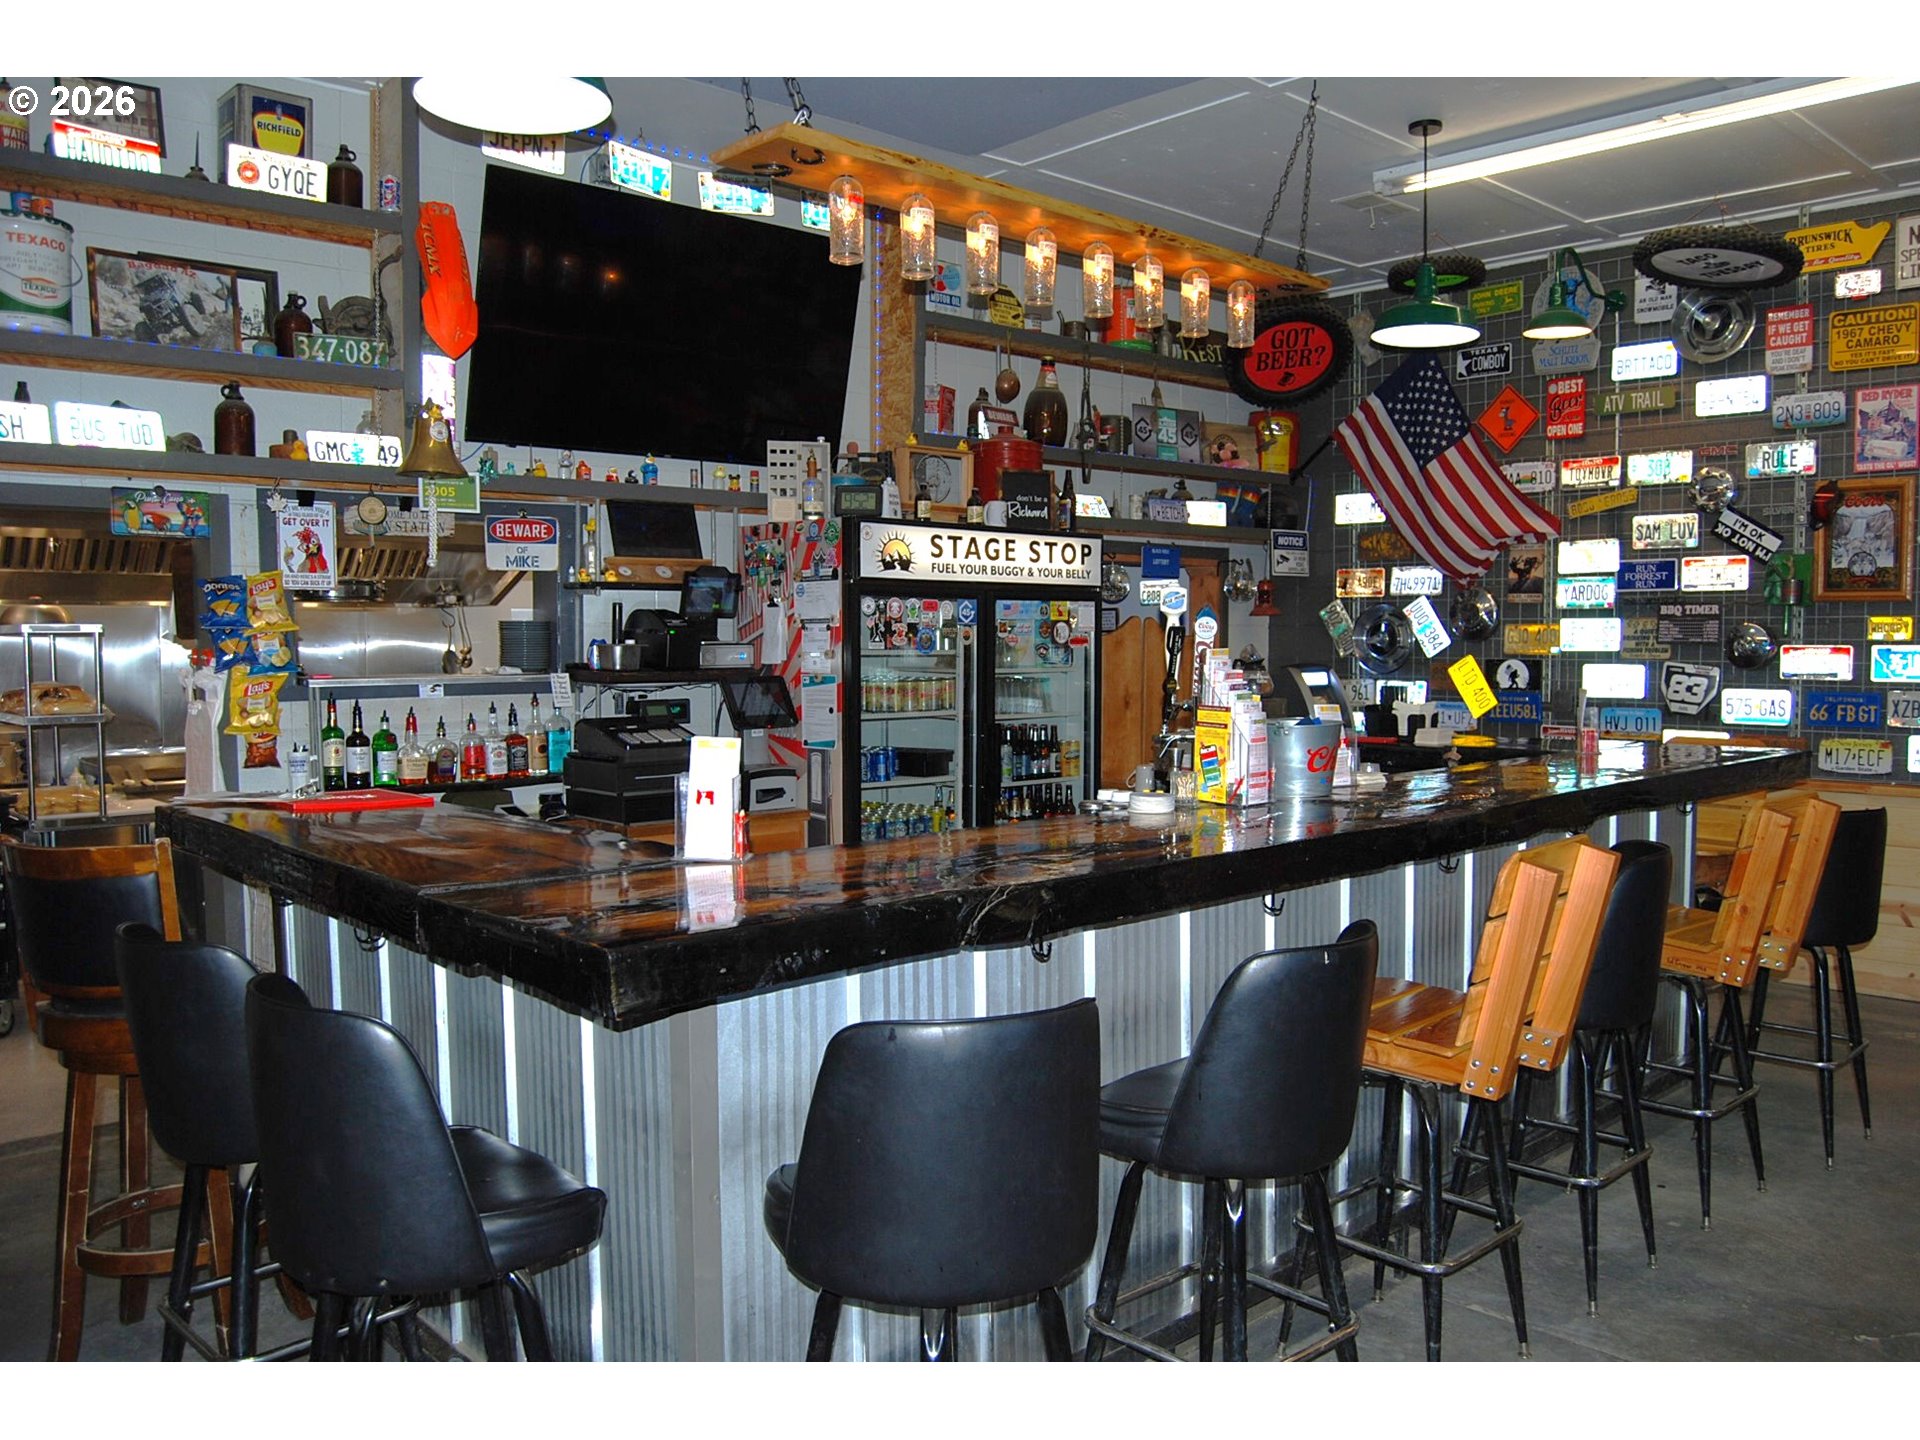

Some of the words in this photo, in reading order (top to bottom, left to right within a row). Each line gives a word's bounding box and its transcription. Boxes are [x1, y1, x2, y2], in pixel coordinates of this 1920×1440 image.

[256, 120, 301, 138] RICHFIELD
[268, 164, 318, 198] GYQE
[6, 231, 66, 253] TEXACO
[1806, 242, 1836, 253] TIRES
[1676, 252, 1719, 266] TACO
[23, 282, 57, 294] TEXACO
[1472, 290, 1491, 301] JOHN
[1494, 285, 1519, 297] DEERE
[930, 292, 951, 304] MOTOR
[951, 296, 961, 307] OIL
[1636, 303, 1675, 314] SNOWMOBILE
[1767, 308, 1810, 321] REMEMBER
[1833, 307, 1916, 327] CAUTION!
[1768, 325, 1778, 335] IF
[1778, 323, 1792, 334] WE
[1793, 321, 1810, 332] GET
[1836, 327, 1864, 340] 1967
[1868, 322, 1912, 336] CHEVY
[1271, 327, 1315, 350] GOT
[1770, 333, 1808, 347] CAUGHT
[1846, 335, 1900, 349] CAMARO
[1256, 345, 1326, 372] BEER?
[1470, 346, 1498, 356] TEXAS
[1864, 350, 1876, 358] IT'S
[1539, 357, 1559, 367] MALT
[1561, 353, 1589, 365] LIQUOR
[1860, 356, 1880, 364] CAN'T
[1557, 378, 1584, 393] BEST
[1604, 394, 1625, 412] ATV
[1631, 390, 1664, 408] TRAIL
[1862, 391, 1879, 402] RED
[1881, 388, 1913, 400] RYDER
[1550, 393, 1584, 423] Beer
[1776, 404, 1803, 423] 2N3
[1812, 401, 1841, 420] 809
[70, 416, 106, 442] BUS
[1158, 428, 1177, 443] 45
[1547, 424, 1566, 437] OPEN
[1567, 422, 1584, 434] ONE
[314, 441, 351, 463] GMC
[1699, 444, 1738, 456] GMC
[1762, 448, 1798, 470] RULE
[1531, 470, 1552, 485] 810
[1844, 494, 1886, 508] Coors
[1007, 501, 1048, 520] Richard
[282, 517, 296, 526] GET
[299, 518, 320, 528] OVER
[322, 519, 330, 528] IT
[395, 521, 445, 534] STATIN
[1714, 523, 1731, 537] OK
[1733, 517, 1748, 532] I'M
[1749, 528, 1766, 543] OK
[496, 523, 549, 538] BEWARE
[1636, 524, 1661, 541] SAM
[1669, 522, 1695, 540] LUV
[1277, 536, 1304, 547] NOTICE
[1731, 533, 1756, 553] NOT
[516, 546, 528, 554] OF
[930, 534, 1016, 562] STAGE
[1029, 540, 1092, 566] STOP
[1756, 547, 1773, 562] I'M
[506, 555, 540, 568] MIKE
[1635, 564, 1657, 573] RUN
[931, 563, 957, 574] FUEL
[959, 564, 988, 576] YOUR
[991, 566, 1024, 577] BUGGY
[1028, 567, 1034, 578] &
[1037, 568, 1063, 578] YOUR
[1065, 569, 1092, 580] BELLY
[1625, 571, 1668, 581] FORREST
[252, 579, 275, 594] Lay's
[1635, 580, 1657, 588] RUN
[1564, 584, 1609, 602] YARDOG
[1660, 604, 1683, 616] BBQ
[1684, 604, 1720, 615] TIMER
[1425, 628, 1444, 652] 384
[248, 682, 271, 696] Lay's
[1351, 684, 1370, 701] 961
[1667, 673, 1709, 704] 83
[1726, 697, 1753, 716] 575
[1759, 699, 1786, 717] GAS
[1810, 704, 1828, 721] 66
[1837, 705, 1878, 722] FBGT
[1605, 715, 1628, 731] HVJ
[1635, 716, 1657, 732] 011
[1825, 748, 1850, 765] M17
[1857, 749, 1886, 767] ECF
